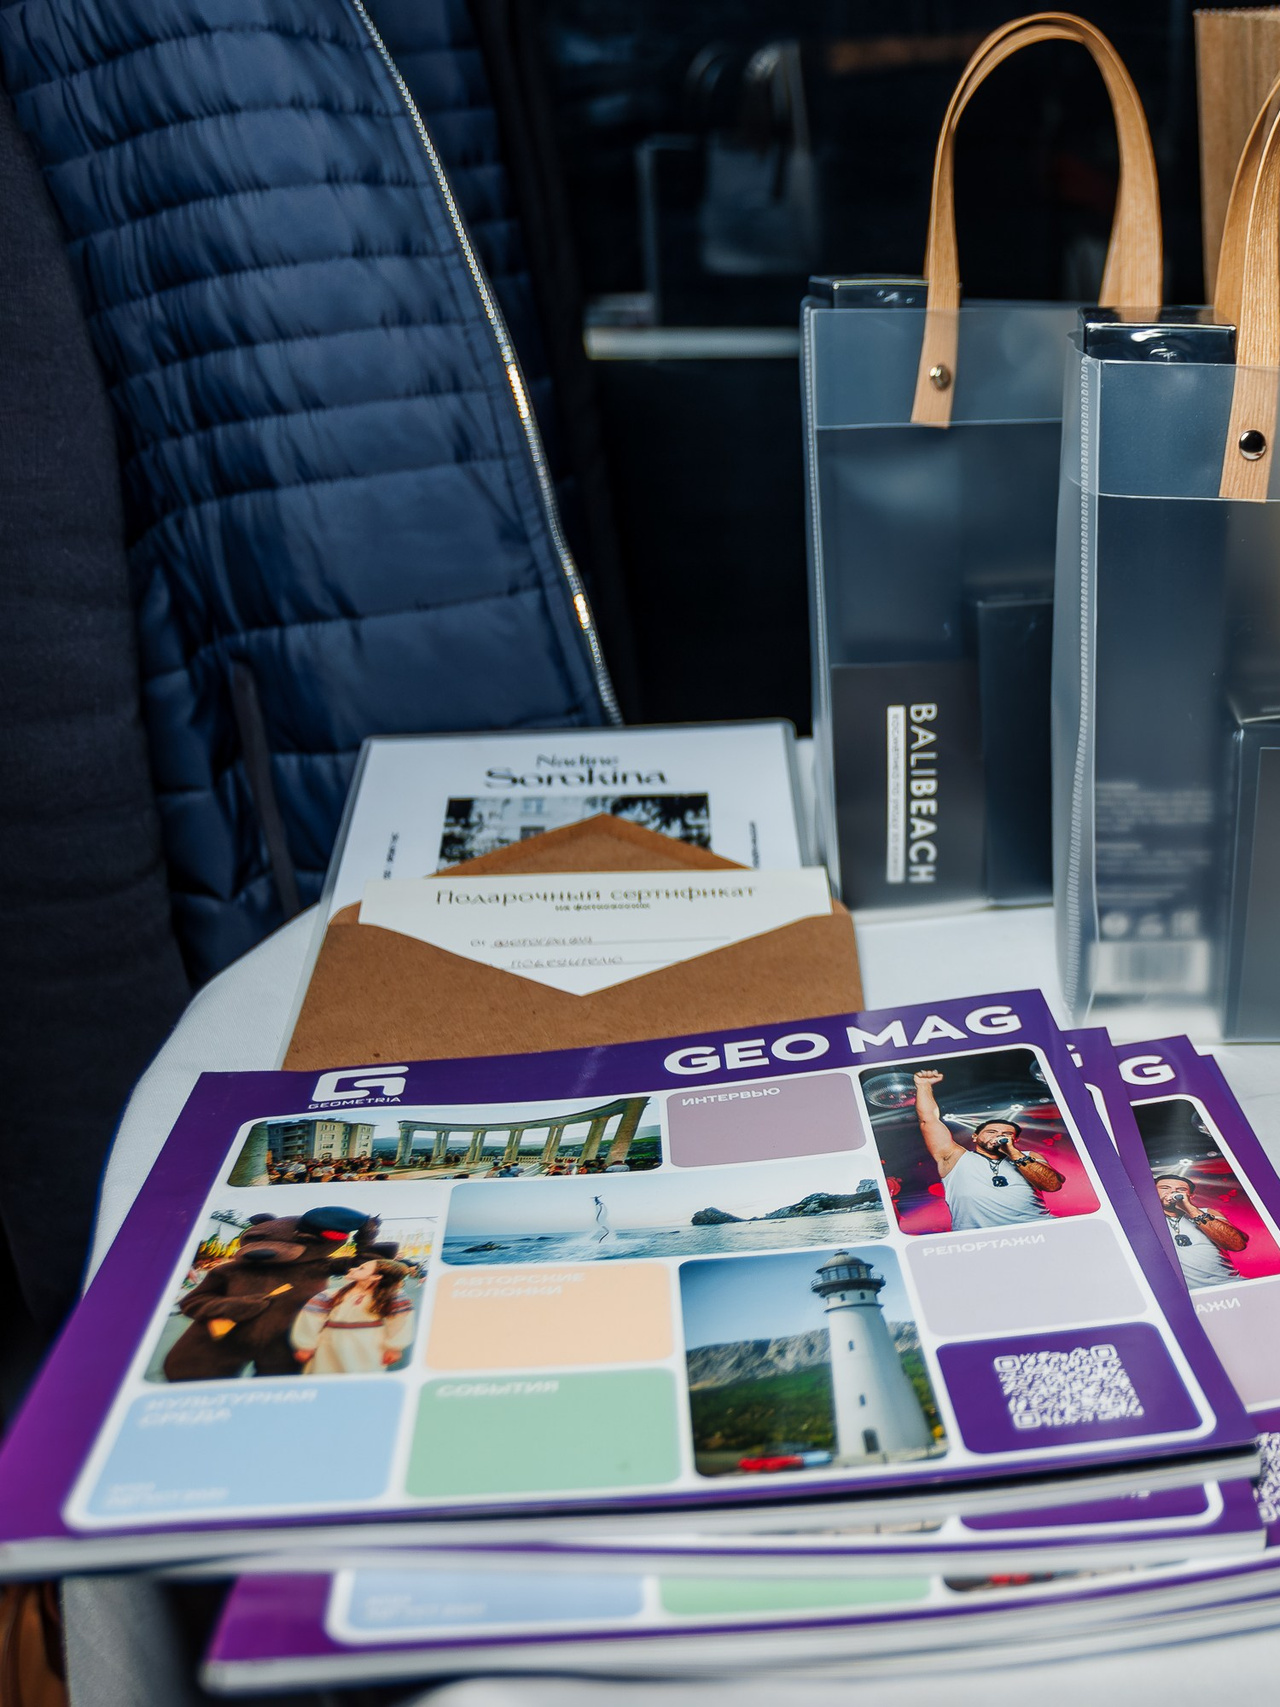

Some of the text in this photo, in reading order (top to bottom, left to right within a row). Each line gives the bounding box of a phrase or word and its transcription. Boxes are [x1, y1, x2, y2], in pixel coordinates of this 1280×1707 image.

[484, 766, 667, 789] Sorokina
[909, 703, 938, 882] BALIBEACH
[663, 1005, 1022, 1075] GEO MAG
[308, 1096, 401, 1110] GEOMETRIA
[681, 1086, 781, 1107] ИНТЕРВЬЮ
[922, 1233, 1046, 1257] РЕПОРТАЖИ
